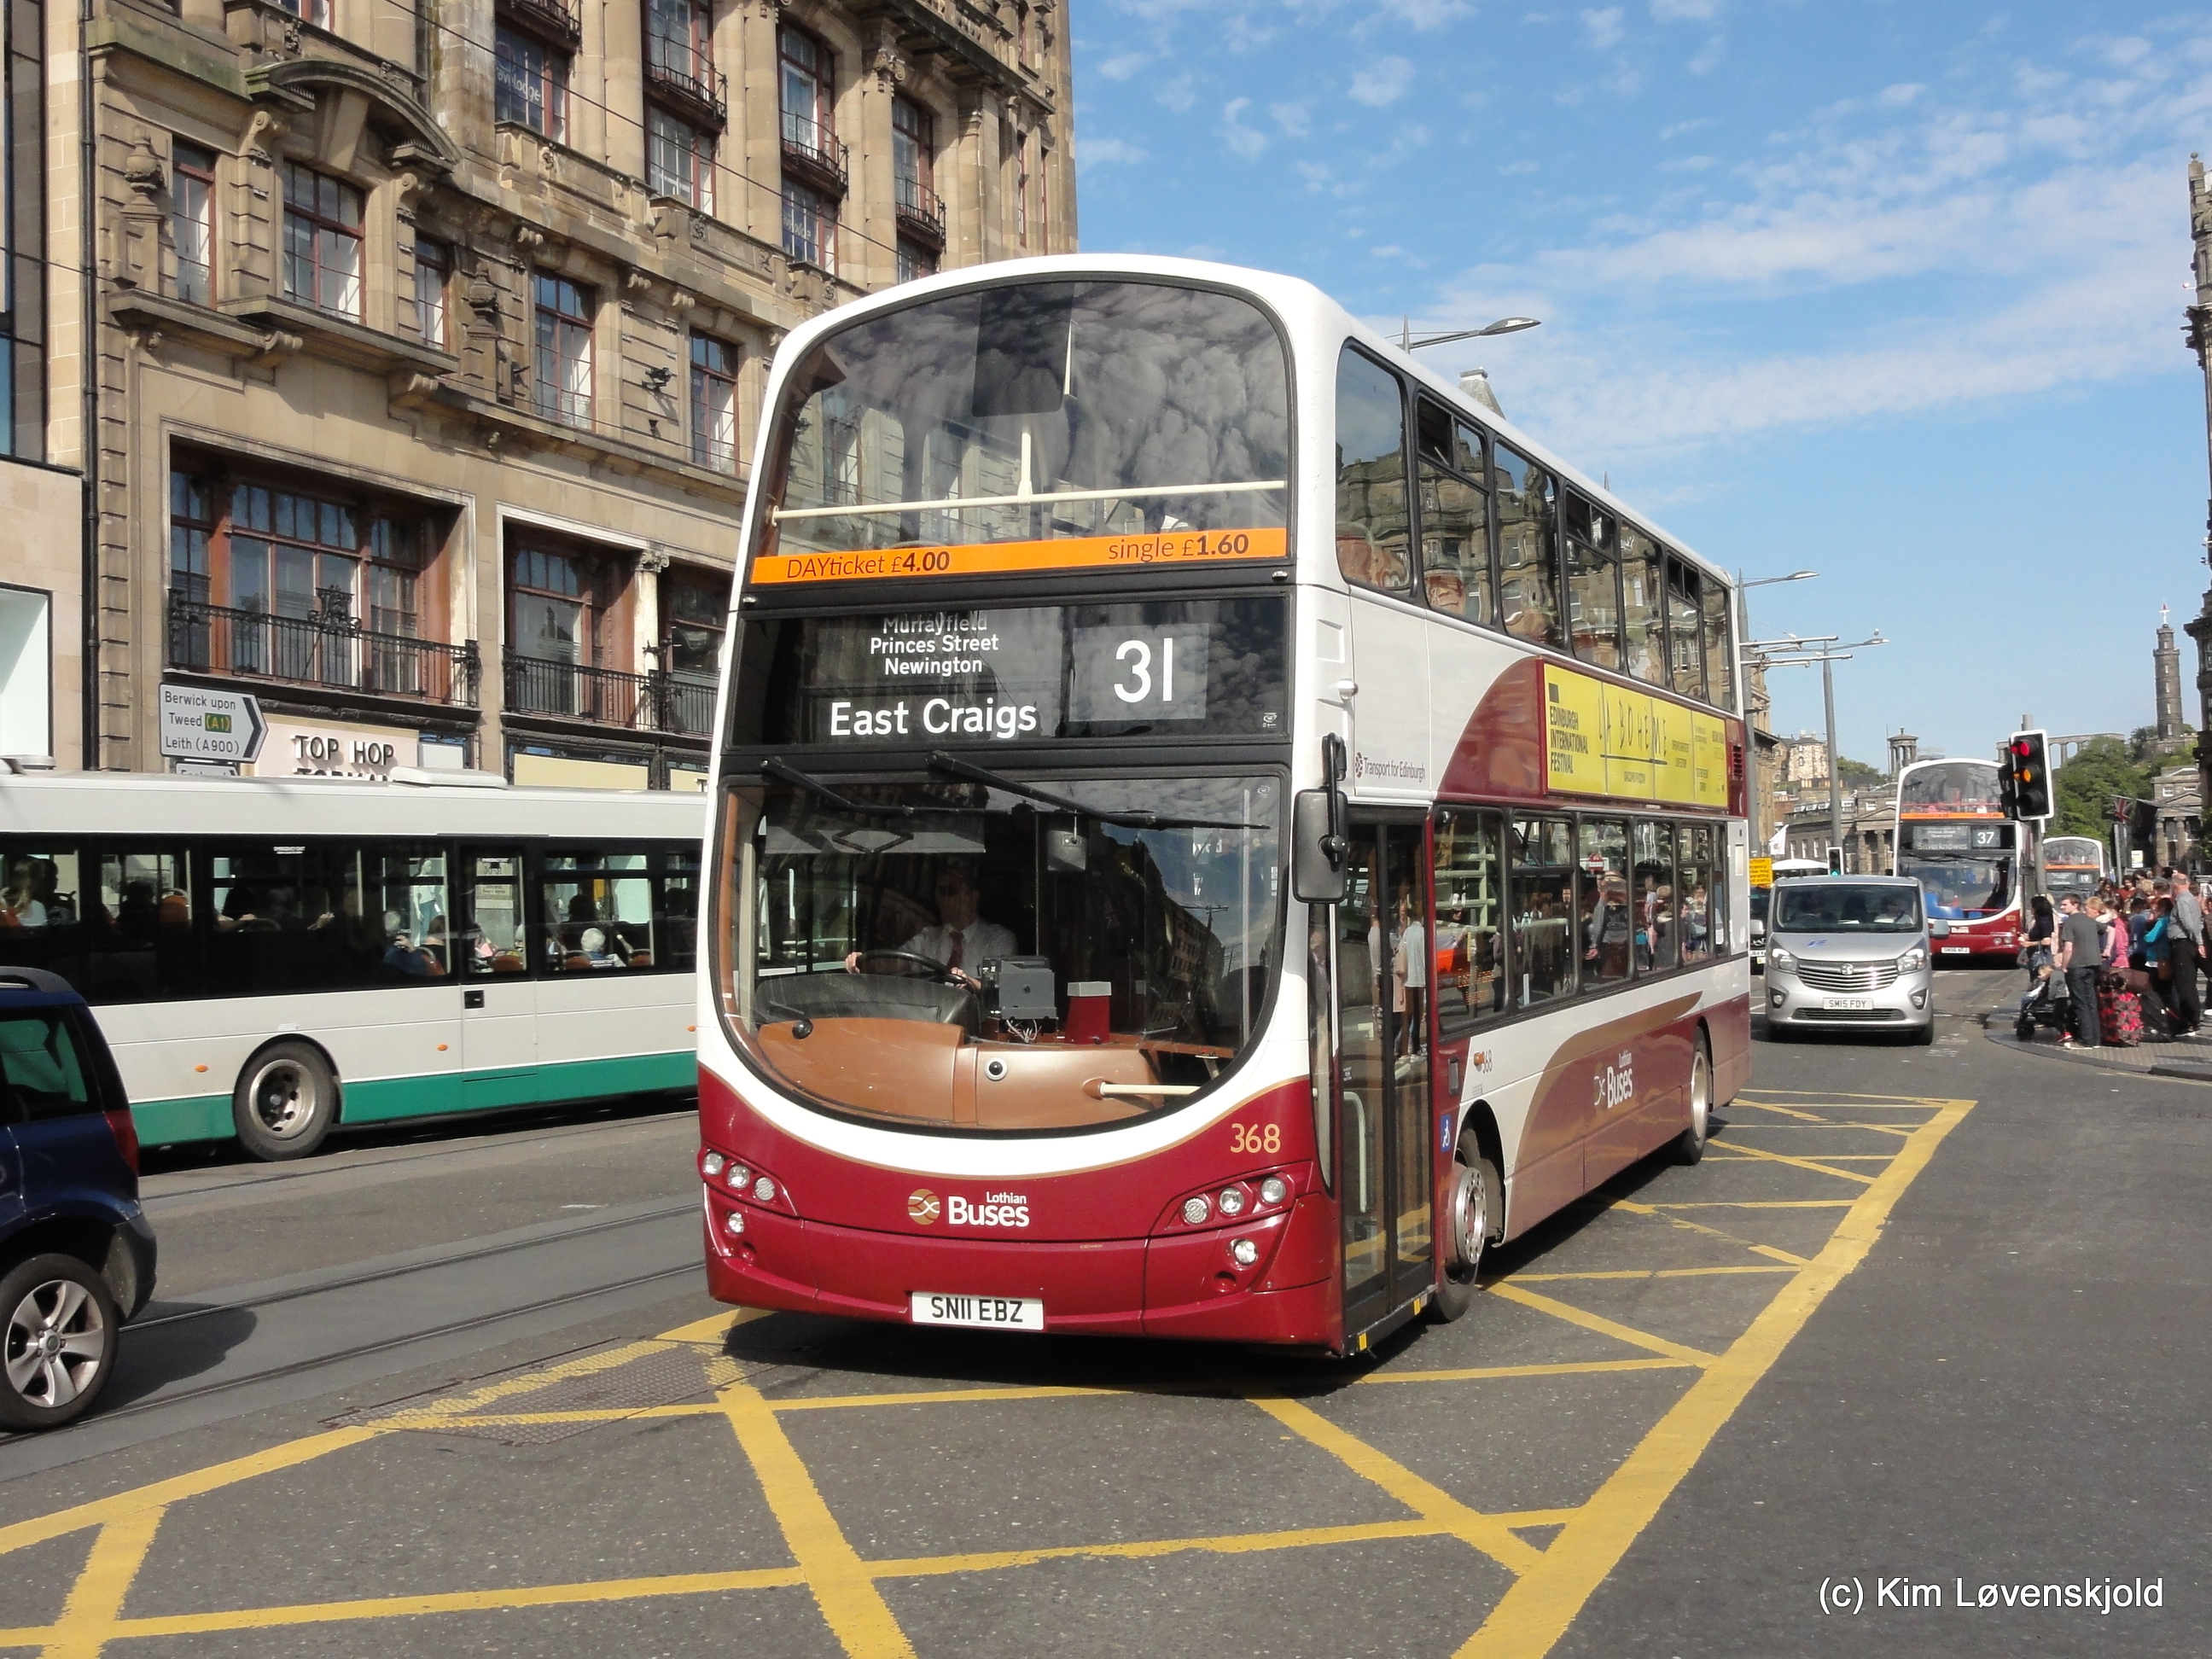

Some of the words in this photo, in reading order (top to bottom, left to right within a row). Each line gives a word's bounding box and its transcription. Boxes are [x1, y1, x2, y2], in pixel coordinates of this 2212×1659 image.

[1109, 537, 1174, 563] single
[1181, 534, 1249, 557] £1.60
[786, 556, 885, 580] DAYticket
[891, 550, 950, 573] £4.00
[882, 614, 988, 636] Murrayfield
[870, 636, 936, 655] Princes
[941, 633, 999, 654] Street
[884, 656, 983, 678] Newington
[1113, 637, 1173, 704] 31
[165, 691, 207, 707] Berwick
[211, 698, 236, 711] upon
[169, 713, 202, 727] Tweed
[206, 714, 231, 731] (A1)
[830, 700, 909, 736] East
[922, 698, 1038, 740] Craigs
[1549, 706, 1579, 731] EDINBURGH
[166, 736, 192, 749] Leith
[196, 737, 240, 755] (A900)
[290, 735, 340, 760] TOP
[349, 741, 394, 765] HOP
[1550, 728, 1589, 754] INTERNATIONAL
[1363, 756, 1390, 779] Transport
[1391, 760, 1400, 777] for
[1400, 761, 1426, 783] Edinburgh
[1550, 751, 1574, 774] FESTIVAL
[1976, 831, 1995, 845] 37
[1828, 999, 1848, 1008] SM15
[1849, 1000, 1867, 1009] FDY
[1618, 1050, 1632, 1068] Lothian
[1607, 1066, 1633, 1109] Buses
[1230, 1122, 1281, 1154] 368
[986, 1190, 1027, 1205] Lothian
[948, 1196, 1030, 1227] Buses
[931, 1295, 972, 1320] SN11
[978, 1298, 1024, 1324] EBZ
